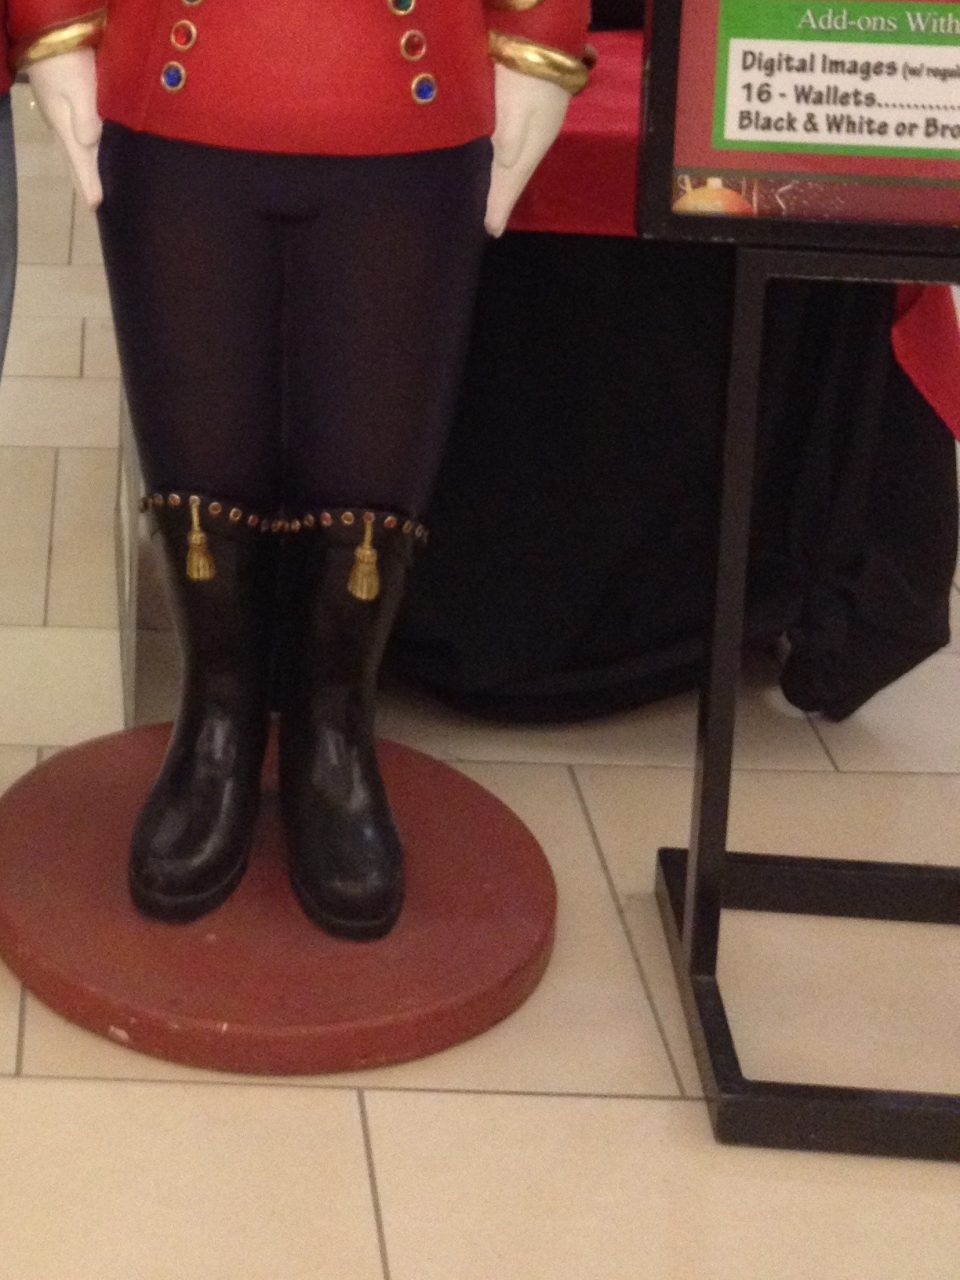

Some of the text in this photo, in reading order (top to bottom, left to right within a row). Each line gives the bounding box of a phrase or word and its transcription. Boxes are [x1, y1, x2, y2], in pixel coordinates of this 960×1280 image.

[798, 8, 960, 34] Add-ons With
[741, 50, 816, 78] Digital
[821, 53, 898, 82] Images
[741, 82, 773, 104] 16
[738, 110, 797, 133] Black
[803, 112, 820, 133] &
[825, 112, 889, 136] White
[895, 121, 919, 137] or
